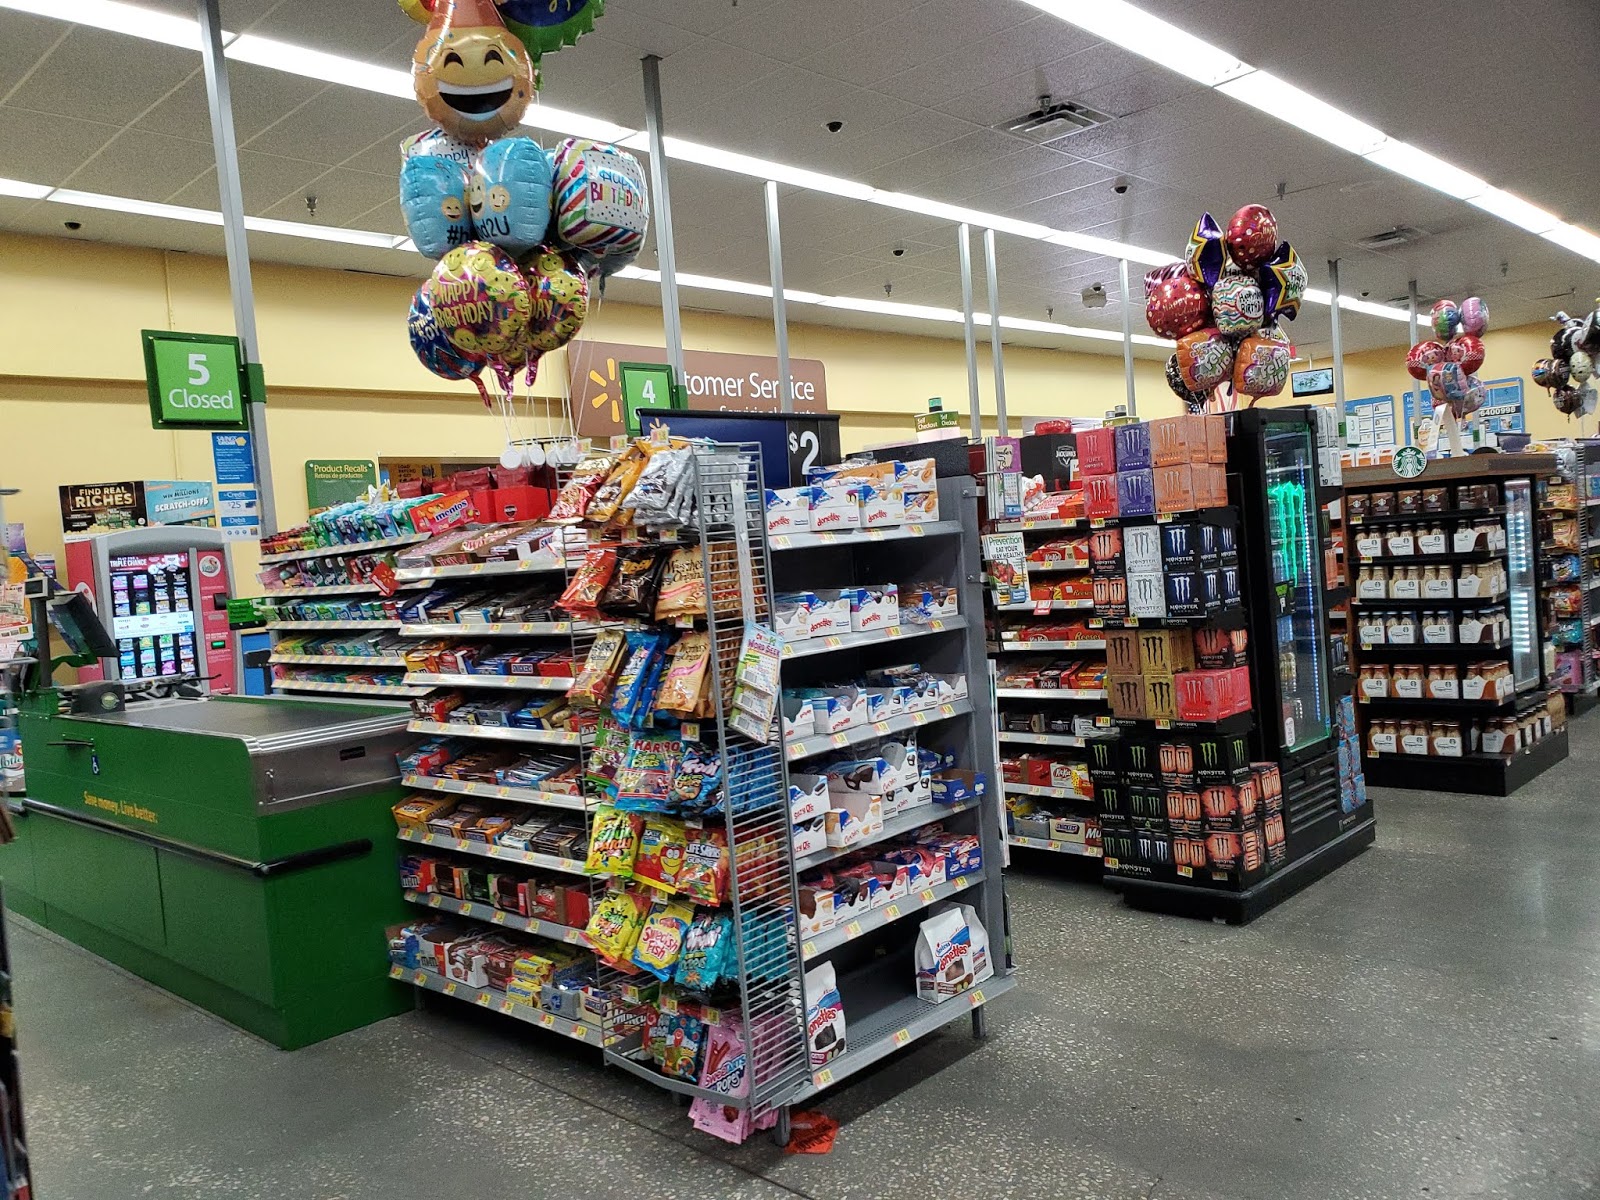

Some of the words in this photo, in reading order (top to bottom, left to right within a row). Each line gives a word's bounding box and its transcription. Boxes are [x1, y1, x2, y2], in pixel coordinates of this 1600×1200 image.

[440, 276, 479, 305] HAPPY
[435, 301, 494, 329] BIRTHDAY
[187, 353, 210, 386] 5
[642, 380, 656, 404] 4
[683, 371, 744, 398] tomer
[749, 372, 815, 400] Serice
[168, 387, 234, 410] Closed
[917, 421, 938, 430] Checkout
[788, 430, 820, 476] $2
[313, 464, 343, 474] Product
[344, 465, 368, 473] Recalls
[75, 493, 133, 508] RICHES
[79, 488, 101, 496] FIND
[103, 486, 127, 494] REAL
[155, 497, 209, 513] SCRATCH-OFFS
[434, 500, 469, 522] mentos
[989, 536, 1023, 547] Prevention
[110, 560, 127, 568] TRIPLE
[127, 559, 148, 567] CHANCE
[1002, 551, 1024, 559] HEALTHY
[1127, 771, 1154, 779] MONSTER
[1118, 863, 1152, 874] MONSTER
[642, 926, 679, 953] Swedish
[646, 940, 667, 960] Fish
[940, 944, 968, 971] donettes
